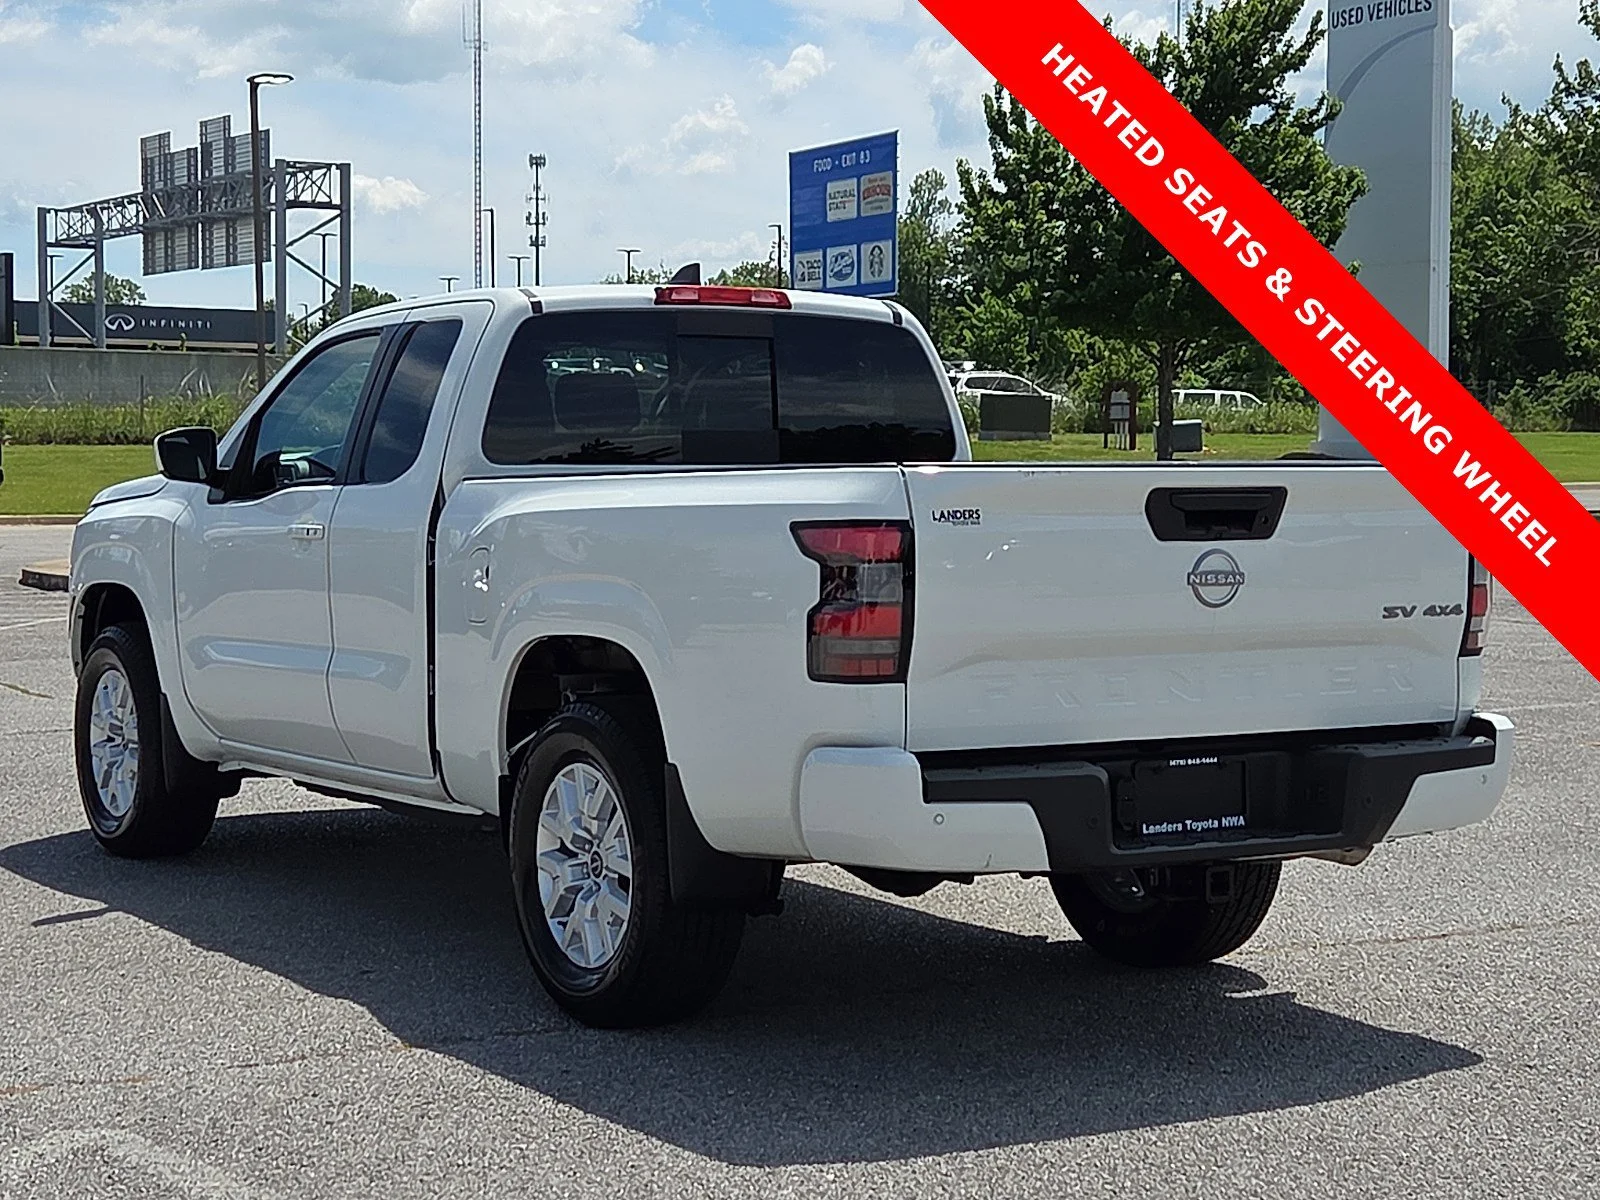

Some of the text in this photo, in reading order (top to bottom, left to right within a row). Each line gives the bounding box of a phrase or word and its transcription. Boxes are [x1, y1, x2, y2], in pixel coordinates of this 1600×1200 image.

[1331, 0, 1432, 29] USED VEHICLES
[813, 157, 832, 173] FOOD
[841, 151, 856, 168] EXIT
[828, 187, 856, 201] NATURAL
[828, 201, 847, 213] STATE
[141, 319, 211, 329] INFINITI
[931, 508, 981, 523] LANDERS
[1188, 574, 1244, 584] NISSAN
[1382, 604, 1418, 619] SV
[967, 655, 1416, 715] FRONTIER
[1142, 815, 1246, 834] Landers Toyota NWA
